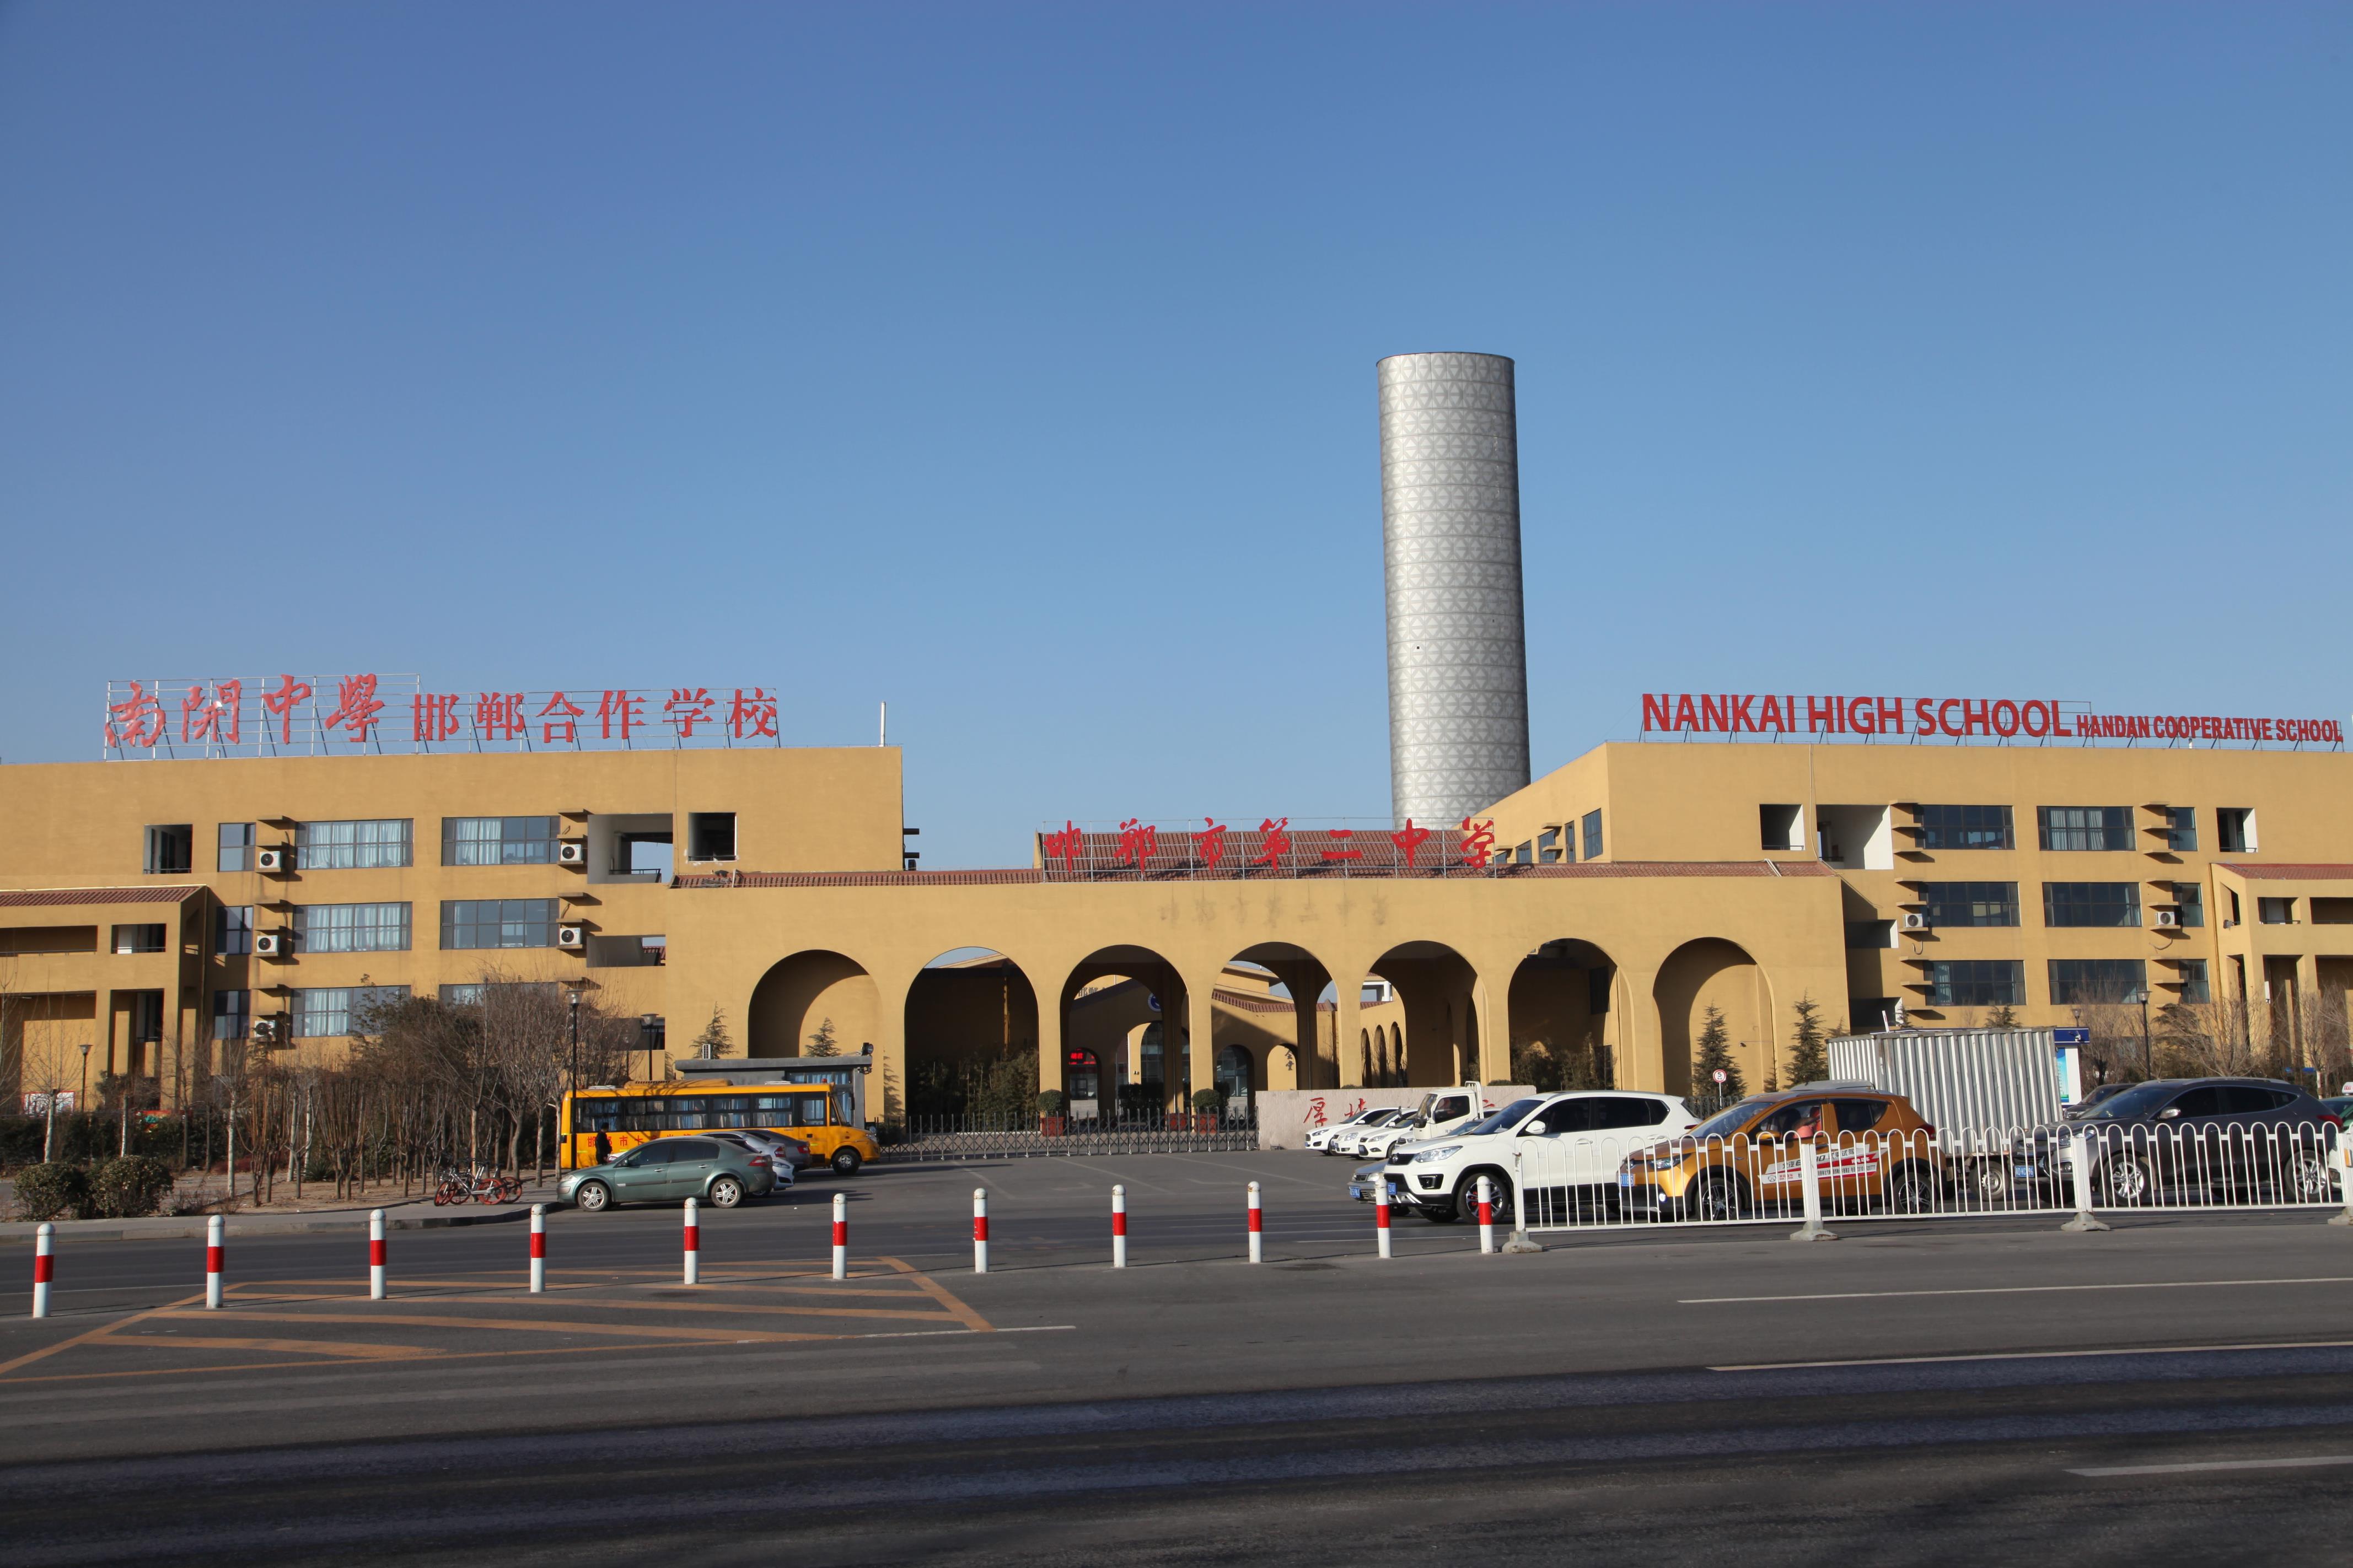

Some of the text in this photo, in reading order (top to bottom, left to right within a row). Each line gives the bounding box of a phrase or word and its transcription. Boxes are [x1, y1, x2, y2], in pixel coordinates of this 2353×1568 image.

[410, 687, 777, 743] 邯郸合作学校
[1642, 693, 2344, 742] NANKAI HIGH SCHOOL HANDAN COOPERATIVE SCHOOL
[1044, 816, 1495, 872] 邯郸市第二中学
